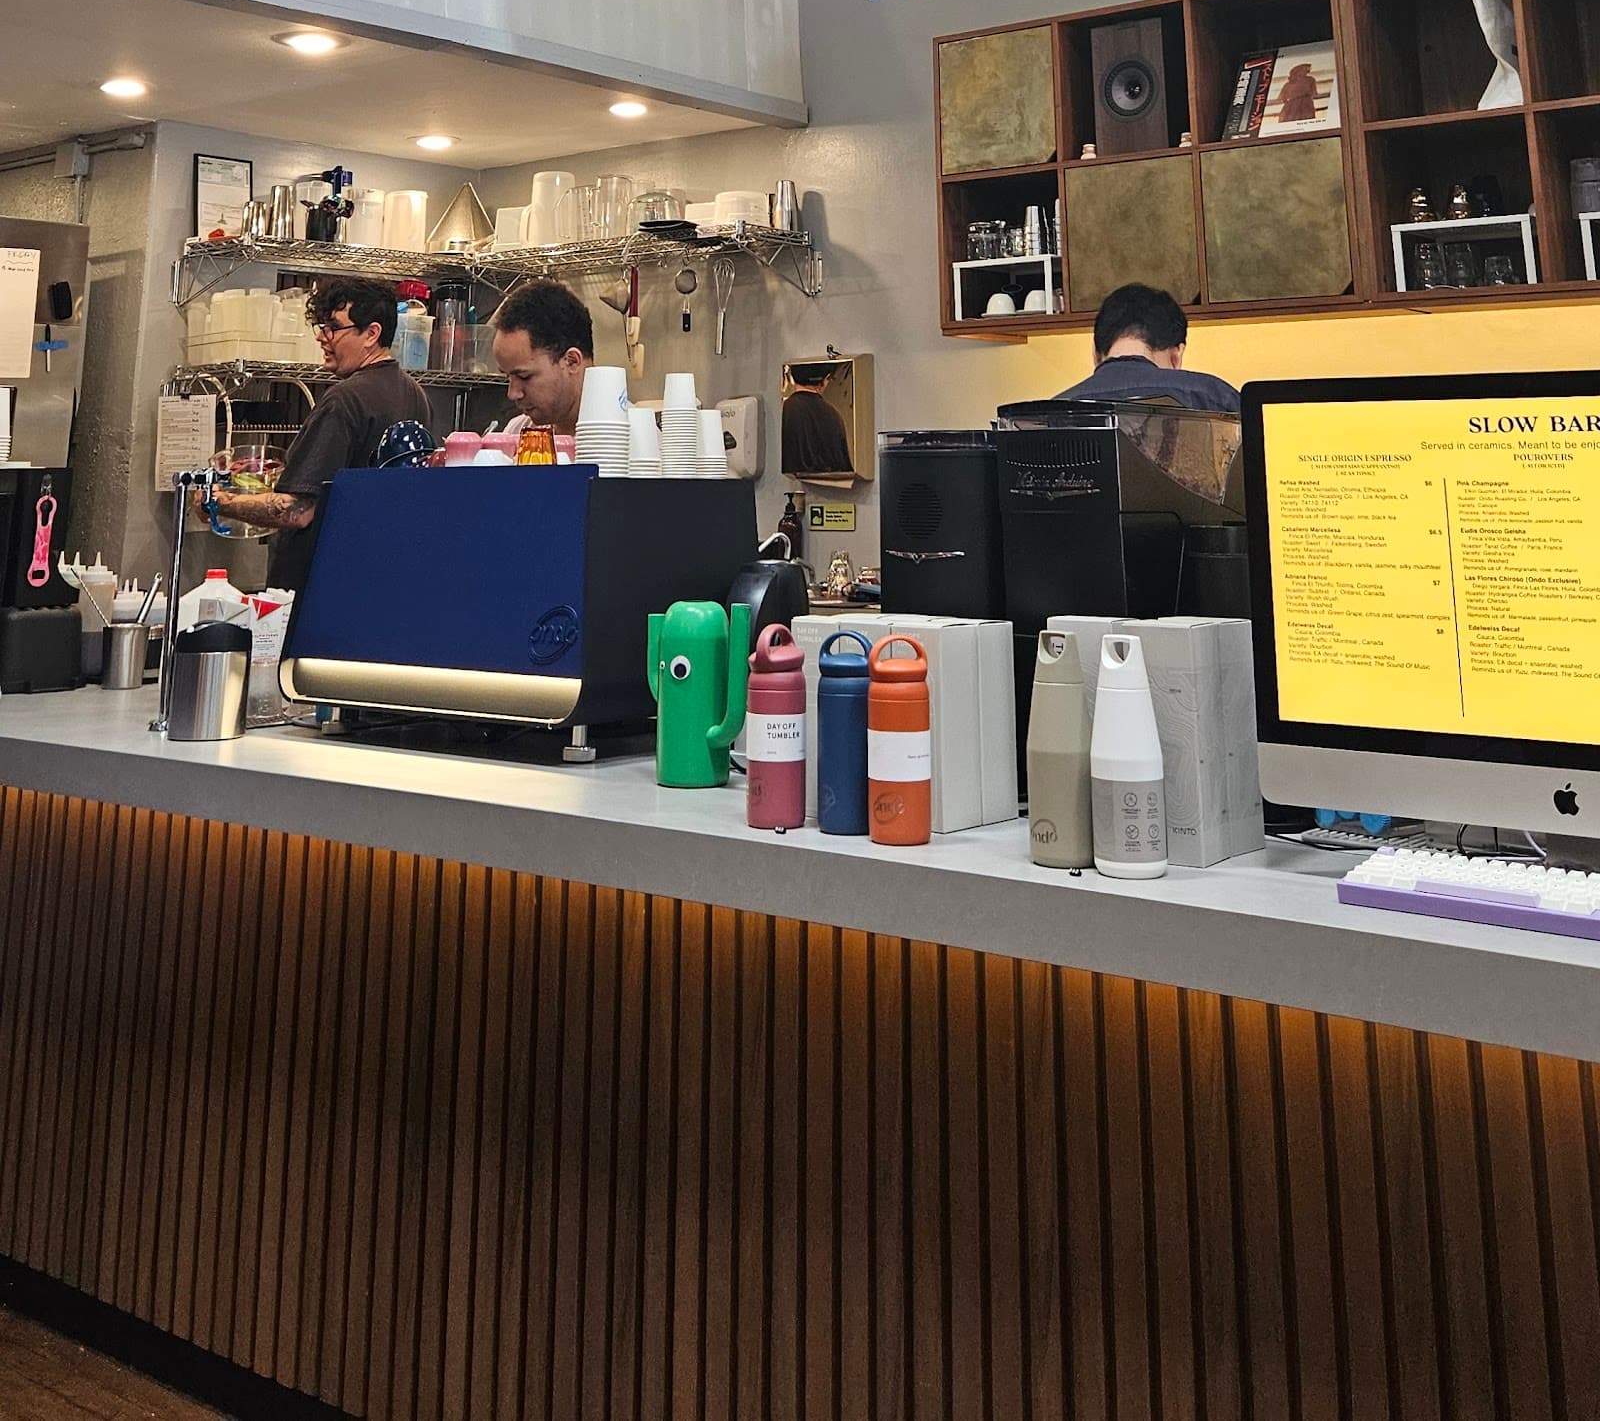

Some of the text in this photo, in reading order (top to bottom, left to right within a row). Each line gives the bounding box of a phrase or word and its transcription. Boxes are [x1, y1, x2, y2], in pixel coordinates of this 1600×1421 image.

[1469, 415, 1600, 433] SLOW BAR
[1518, 441, 1548, 449] Meant
[1552, 441, 1560, 449] to
[1565, 441, 1576, 449] be
[767, 722, 796, 730] DAY OFF
[767, 731, 800, 739] TUMBLER
[1172, 826, 1197, 836] KINTO
